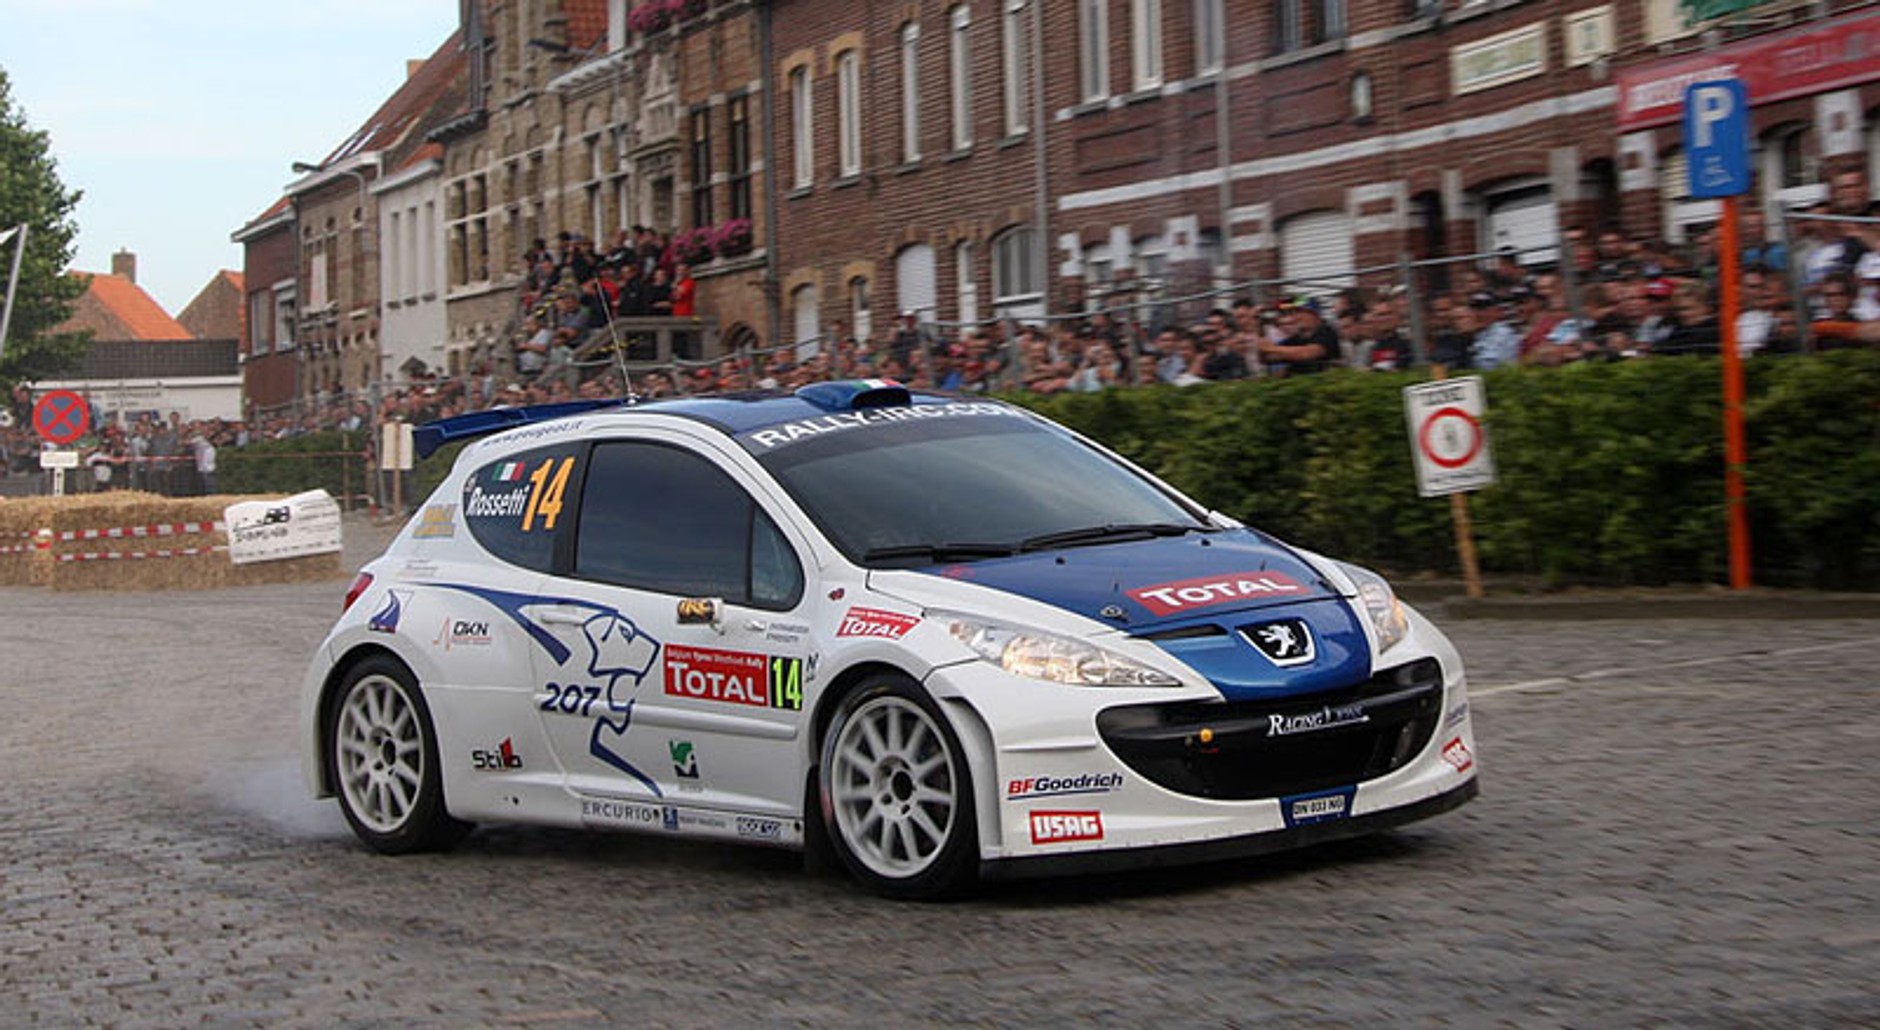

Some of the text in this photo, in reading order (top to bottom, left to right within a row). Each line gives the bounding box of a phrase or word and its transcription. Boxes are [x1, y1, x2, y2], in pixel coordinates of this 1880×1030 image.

[1692, 87, 1734, 147] P
[466, 484, 530, 517] Rossetti
[521, 456, 575, 531] 14
[1140, 577, 1299, 608] TOTAL
[843, 616, 900, 640] TOTAL
[667, 661, 765, 703] TOTAL
[773, 658, 801, 710] 14
[540, 682, 601, 716] 207
[1008, 772, 1123, 794] BFGoodrich
[1033, 815, 1099, 840] USAG
